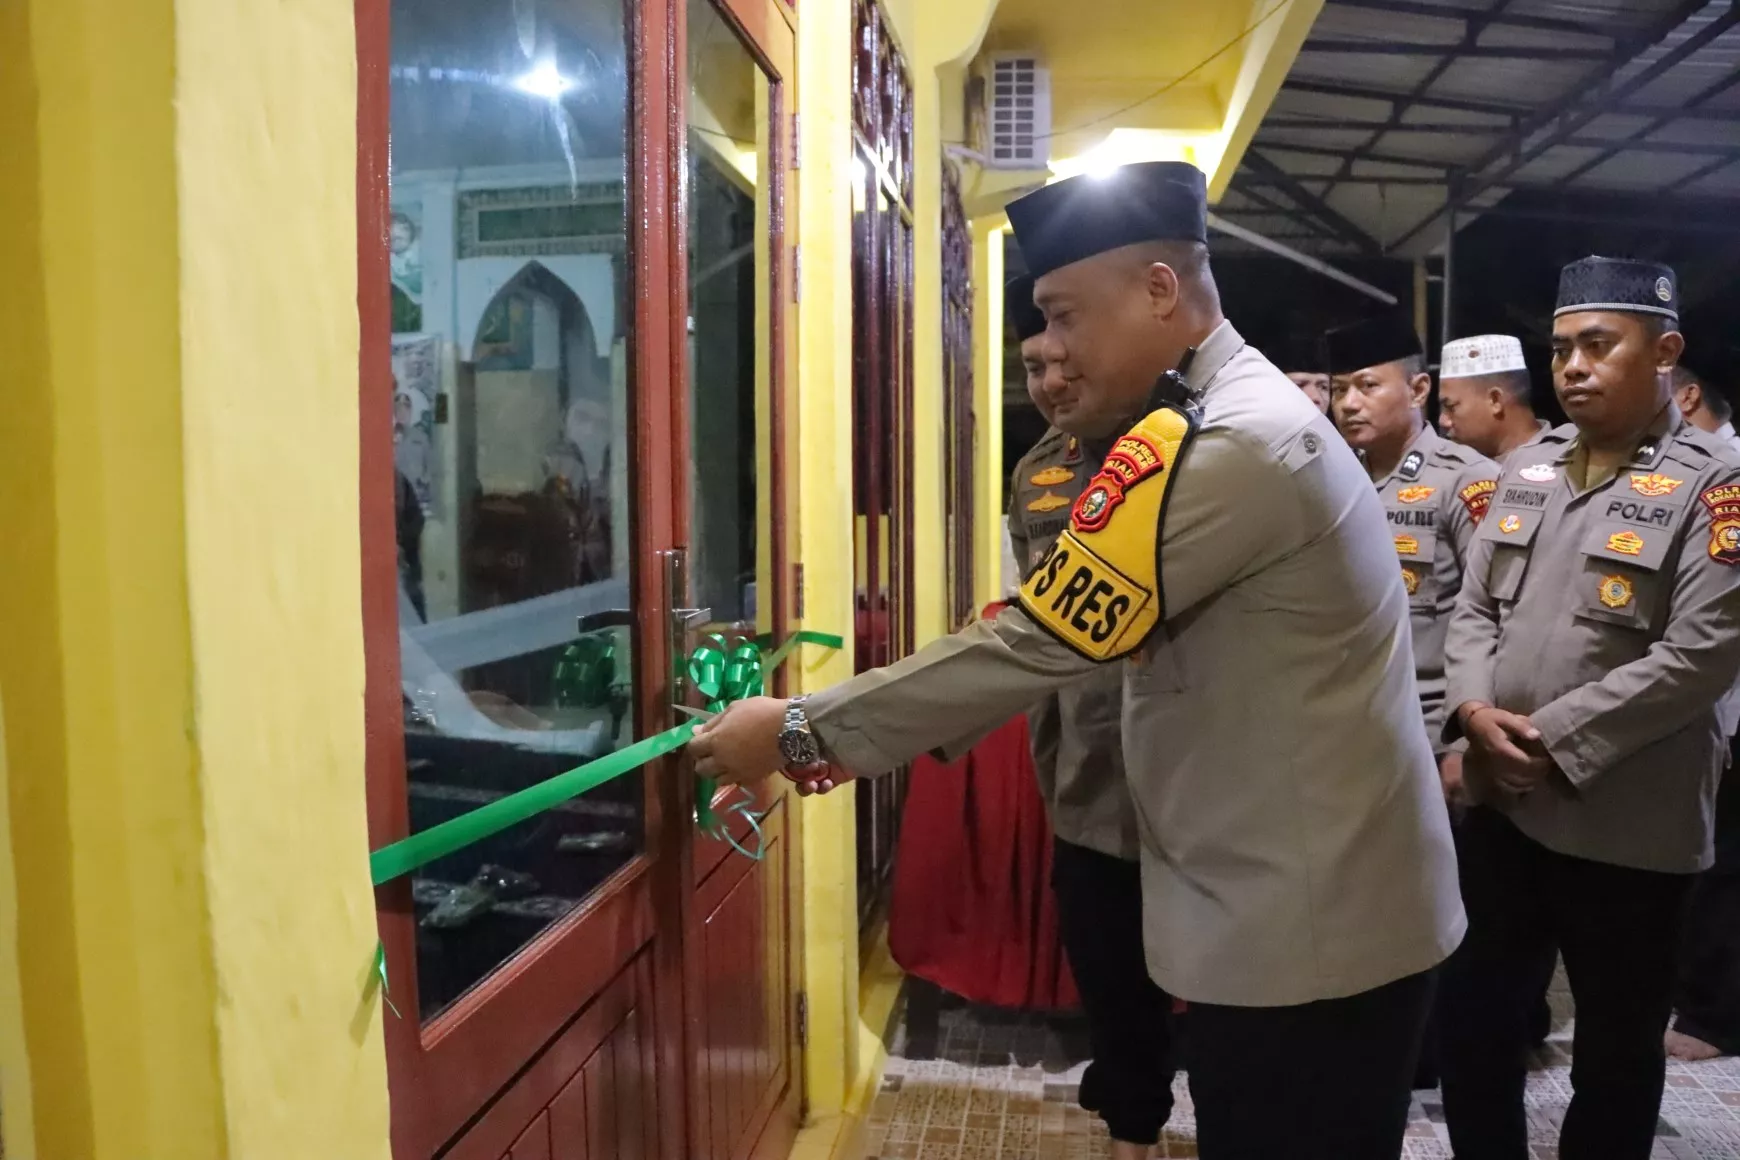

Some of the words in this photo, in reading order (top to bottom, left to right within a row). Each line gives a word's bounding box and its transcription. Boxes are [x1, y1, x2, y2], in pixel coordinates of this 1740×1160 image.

[1106, 460, 1134, 479] RIAU
[1606, 501, 1673, 526] POLRI
[1051, 565, 1130, 643] RES
